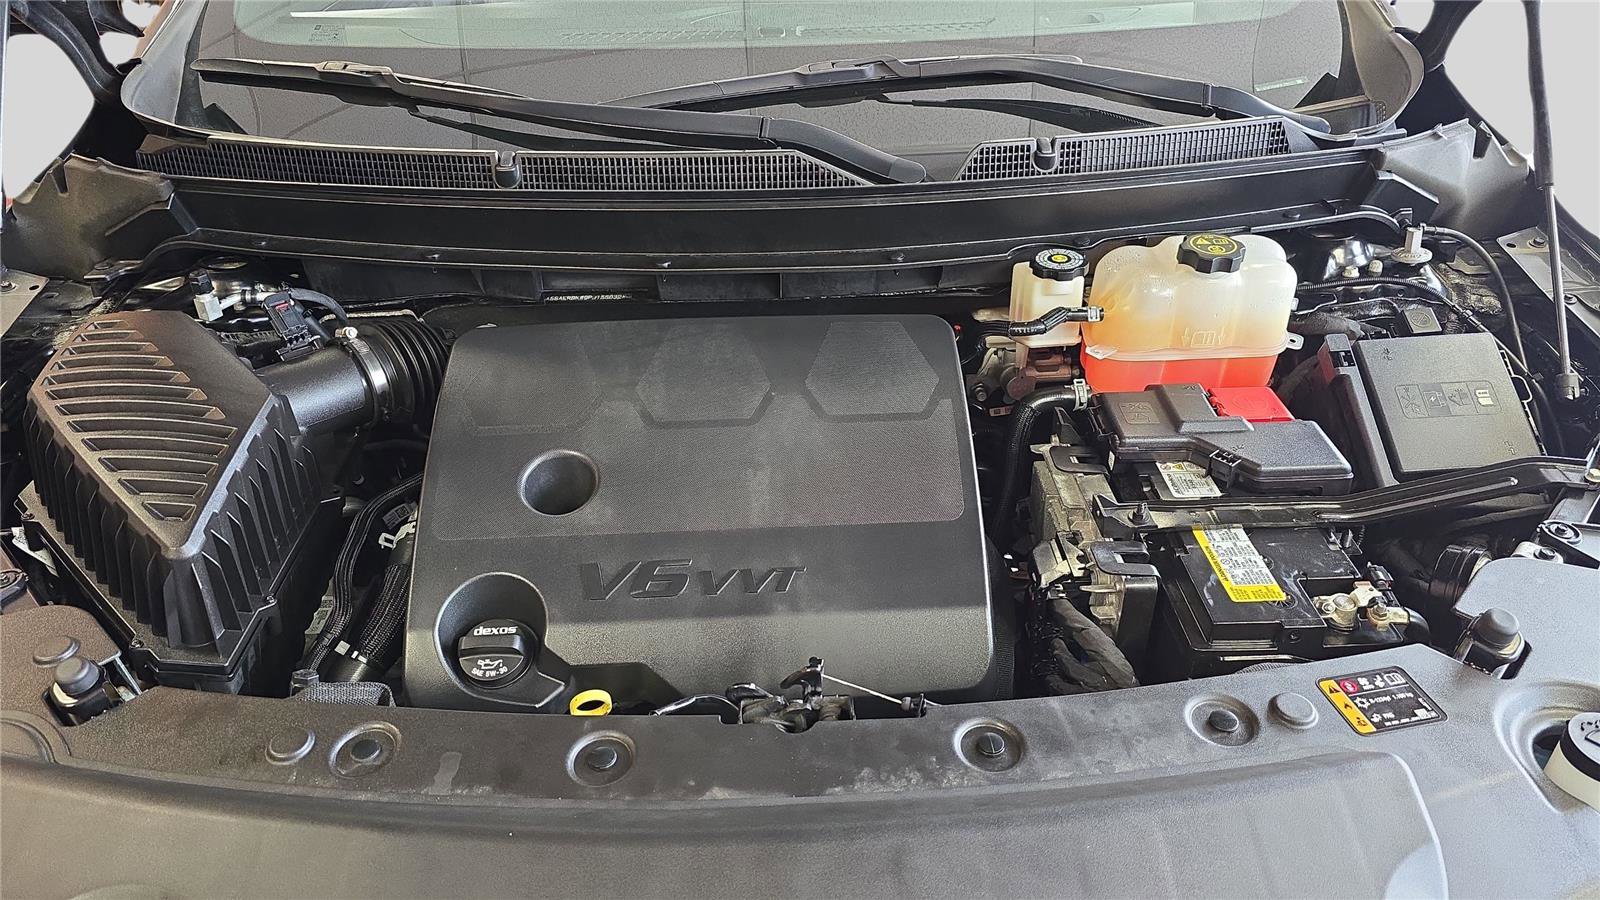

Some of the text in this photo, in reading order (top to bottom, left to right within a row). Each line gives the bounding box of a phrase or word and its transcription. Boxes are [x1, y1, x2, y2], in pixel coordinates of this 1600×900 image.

[580, 558, 807, 601] V6 VVT
[473, 626, 519, 636] dexos
[471, 666, 508, 677] SAE 5W-30
